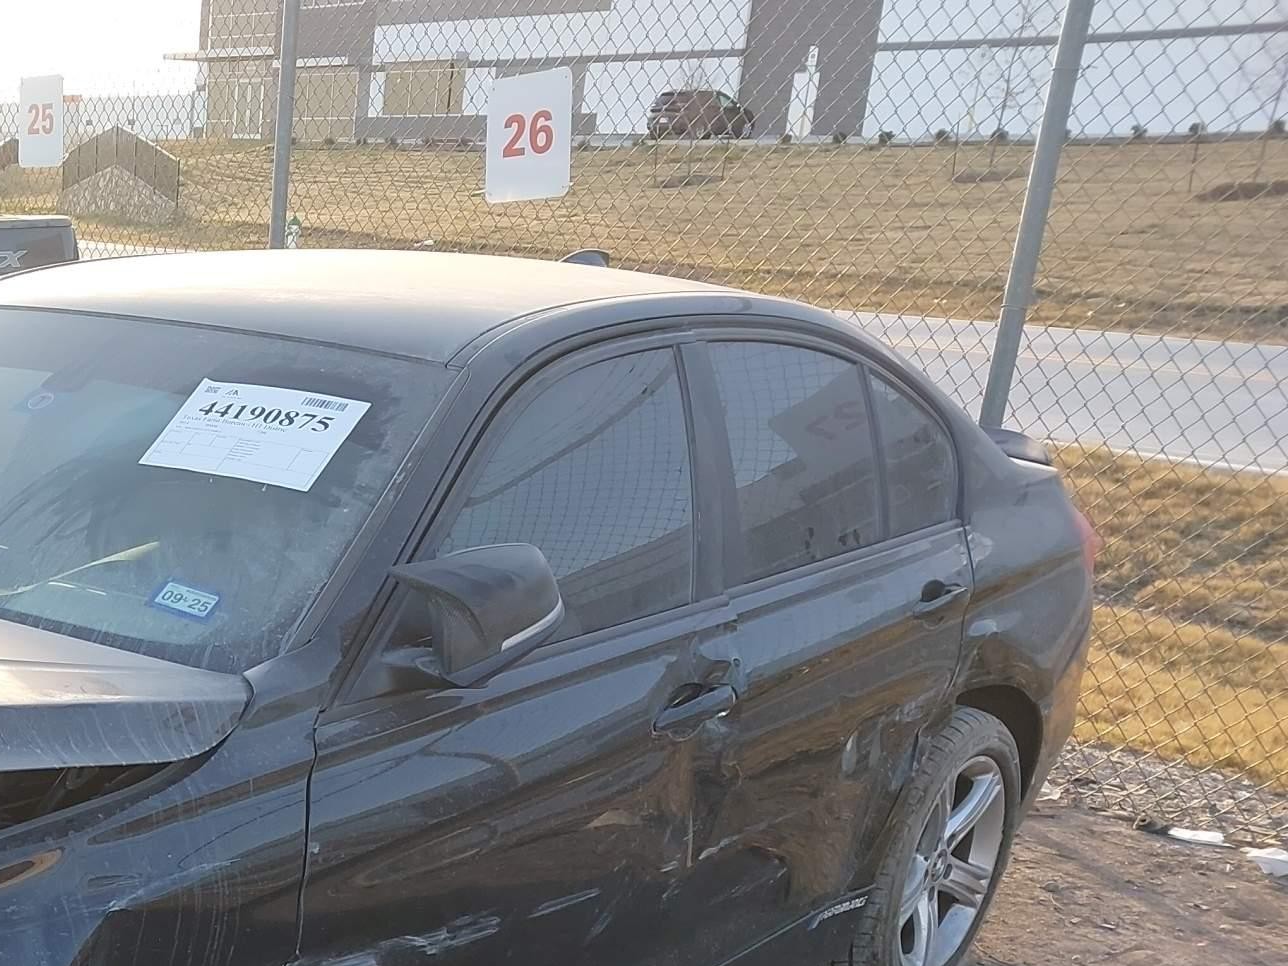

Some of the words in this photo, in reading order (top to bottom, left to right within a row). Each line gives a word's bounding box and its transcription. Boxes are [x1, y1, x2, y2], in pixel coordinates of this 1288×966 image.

[27, 103, 54, 135] 25
[502, 109, 554, 158] 26
[198, 400, 336, 432] 44190875
